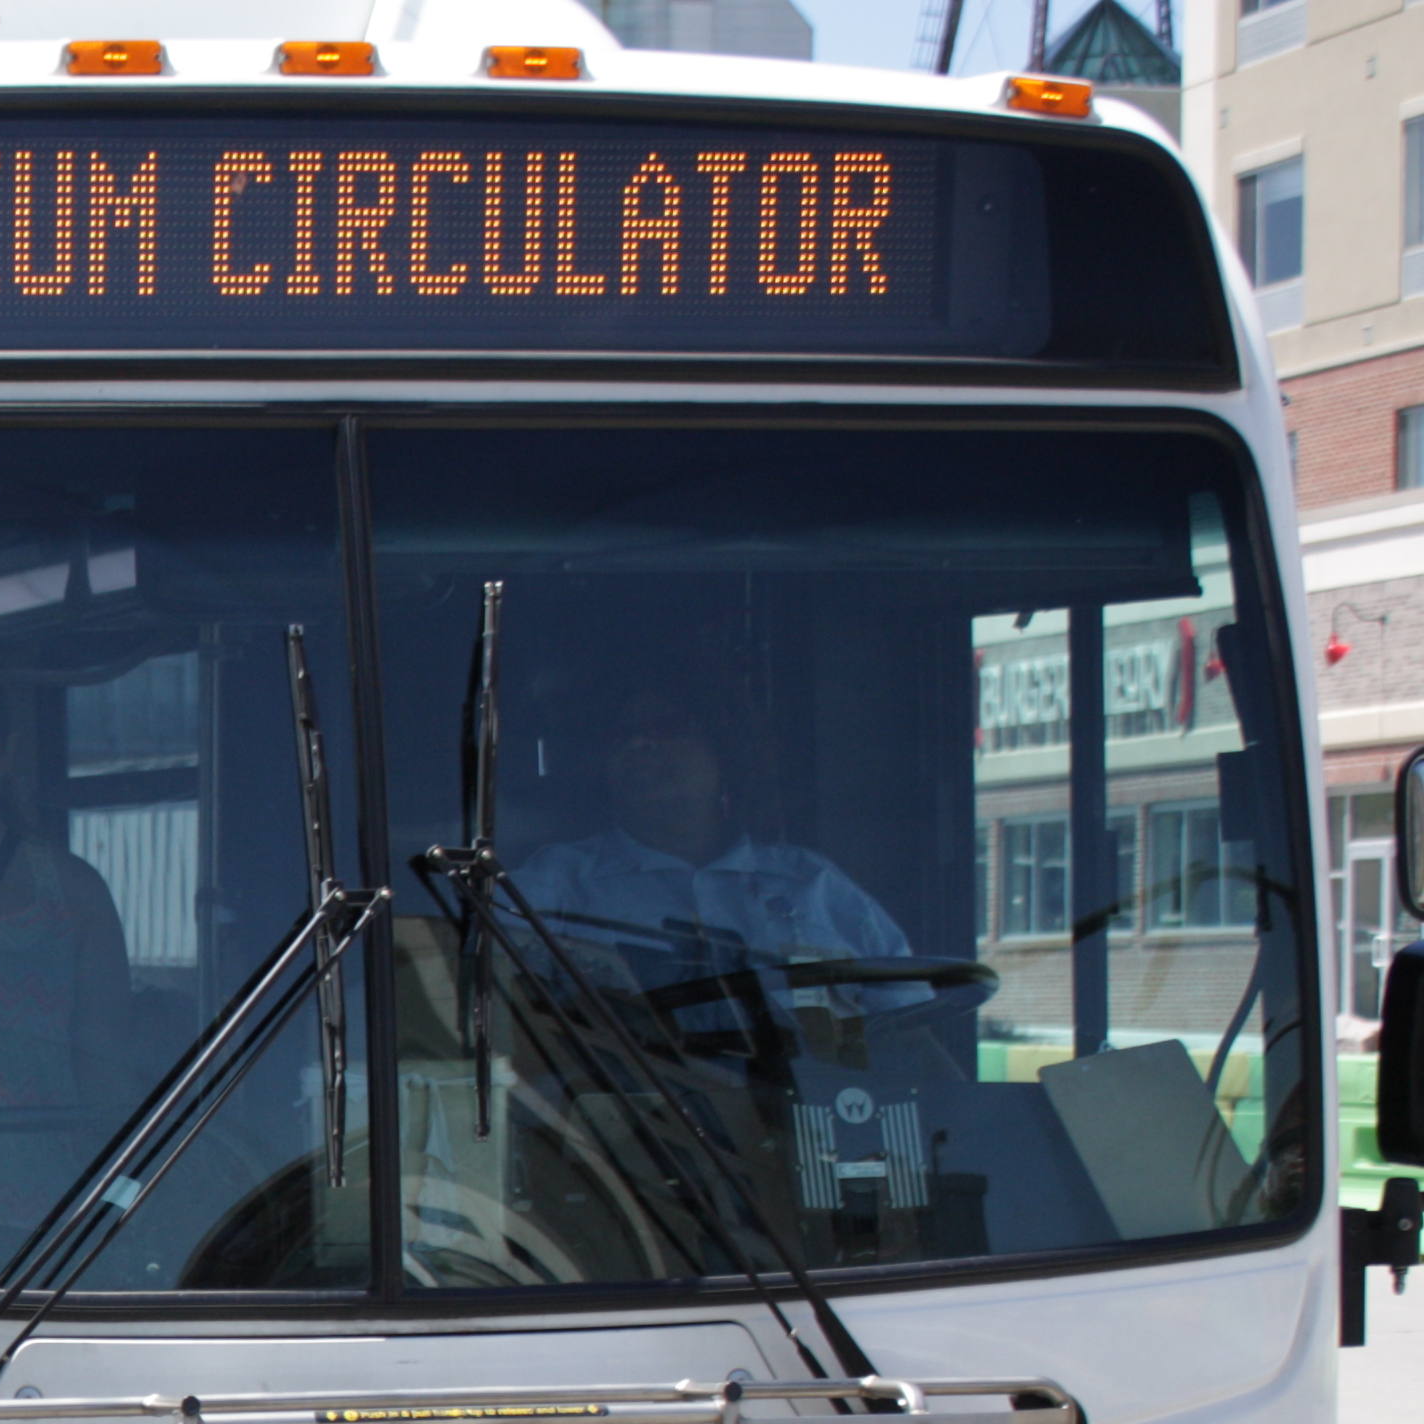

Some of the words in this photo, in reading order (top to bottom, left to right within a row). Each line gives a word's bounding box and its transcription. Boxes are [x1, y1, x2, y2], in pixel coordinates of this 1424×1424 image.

[213, 151, 889, 296] CIRCULATOR
[979, 654, 1070, 729] BURGER
[360, 1411, 386, 1419] Push
[412, 1409, 431, 1418] pull
